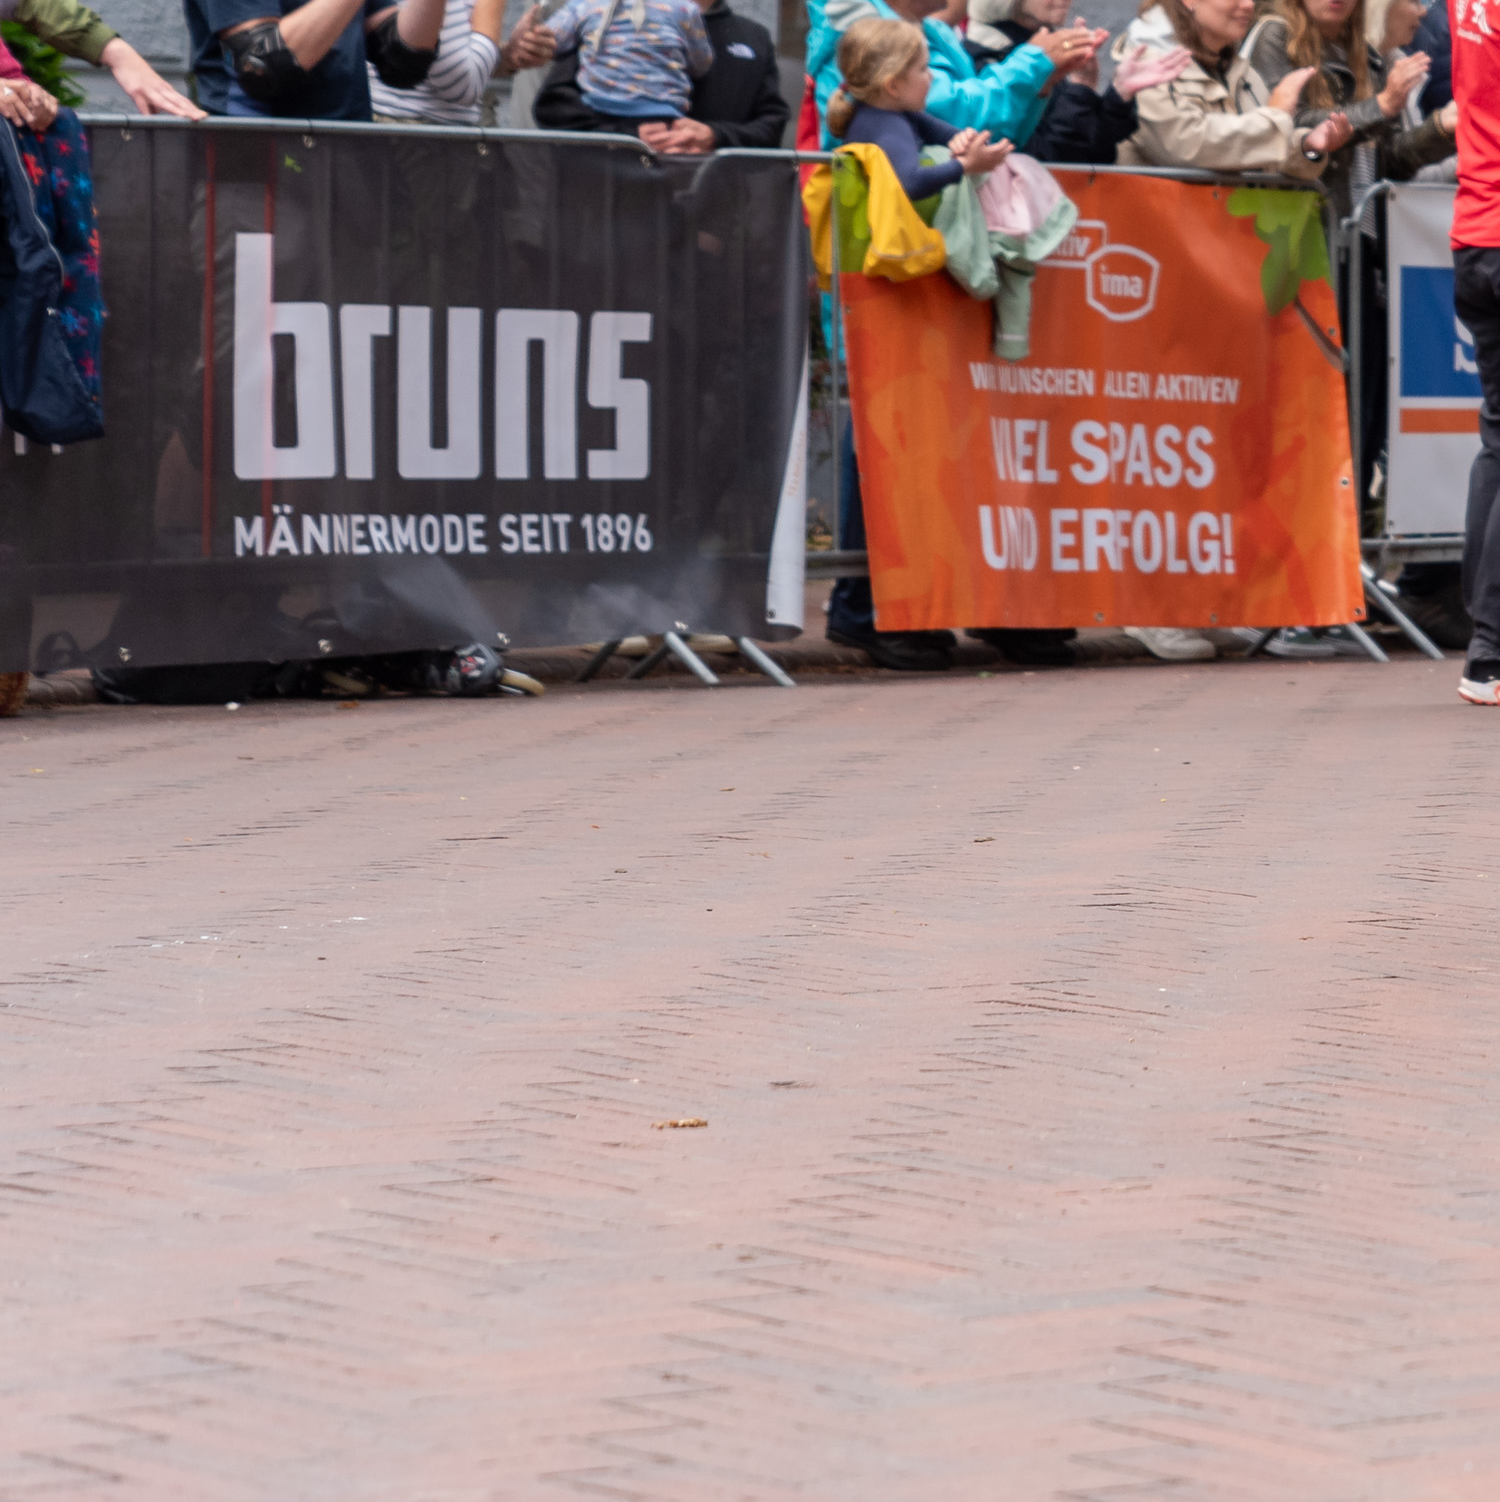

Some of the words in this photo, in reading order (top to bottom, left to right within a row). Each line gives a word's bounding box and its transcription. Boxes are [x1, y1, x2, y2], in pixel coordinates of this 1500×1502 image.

[234, 232, 654, 480] bruns
[1104, 370, 1150, 399] ALLEN
[1155, 373, 1240, 404] AKTIVEN
[1070, 419, 1217, 489] SPASS
[233, 504, 490, 556] MÄNNERMODE
[500, 513, 573, 554] SEIT
[581, 513, 653, 553] 1896
[978, 504, 1039, 572] UND
[1051, 507, 1236, 576] ERFOLG!
